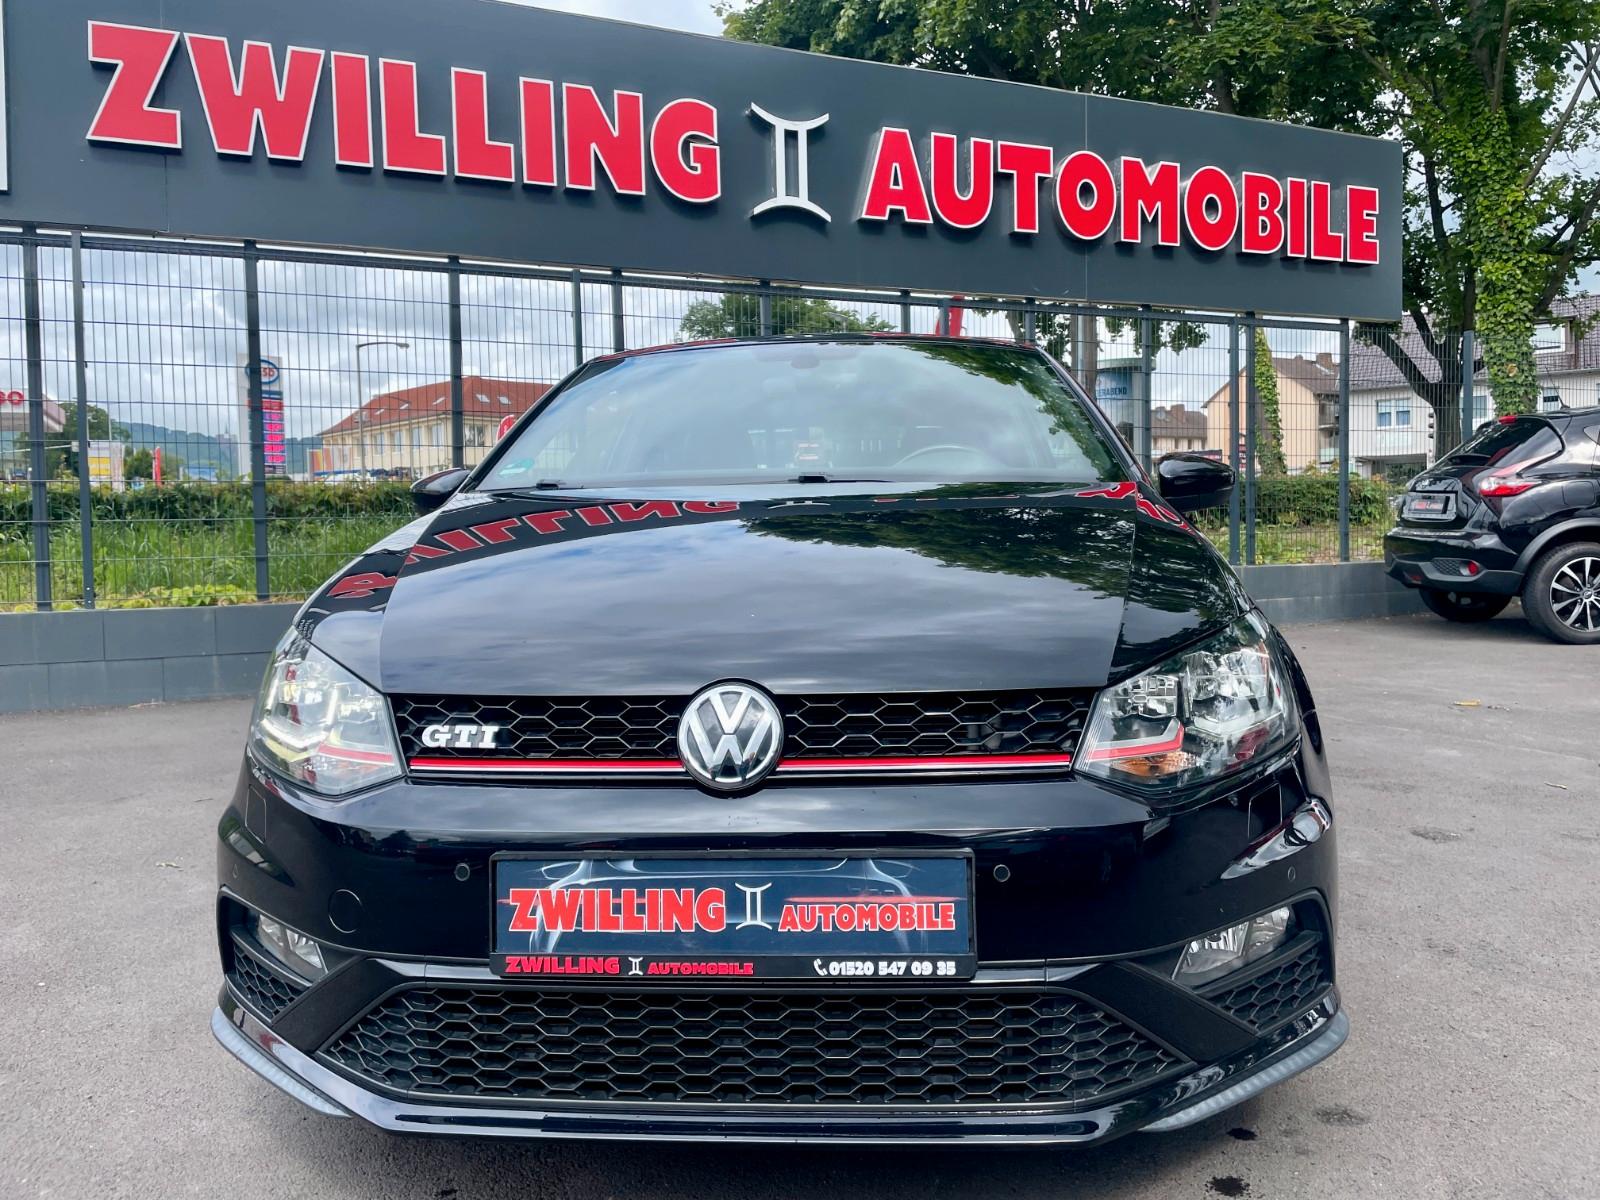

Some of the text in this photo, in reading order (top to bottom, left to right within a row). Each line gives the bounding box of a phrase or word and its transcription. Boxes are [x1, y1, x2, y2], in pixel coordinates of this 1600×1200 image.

[86, 20, 1380, 266] ZWILLING AUTOMOBILE
[421, 723, 500, 749] GTI
[682, 684, 780, 788] VW
[508, 887, 956, 933] ZWILLING AUTOMOBILE
[504, 956, 754, 976] ZWILLING AUTOMOBILE
[828, 961, 957, 976] 01520 547 09 35
